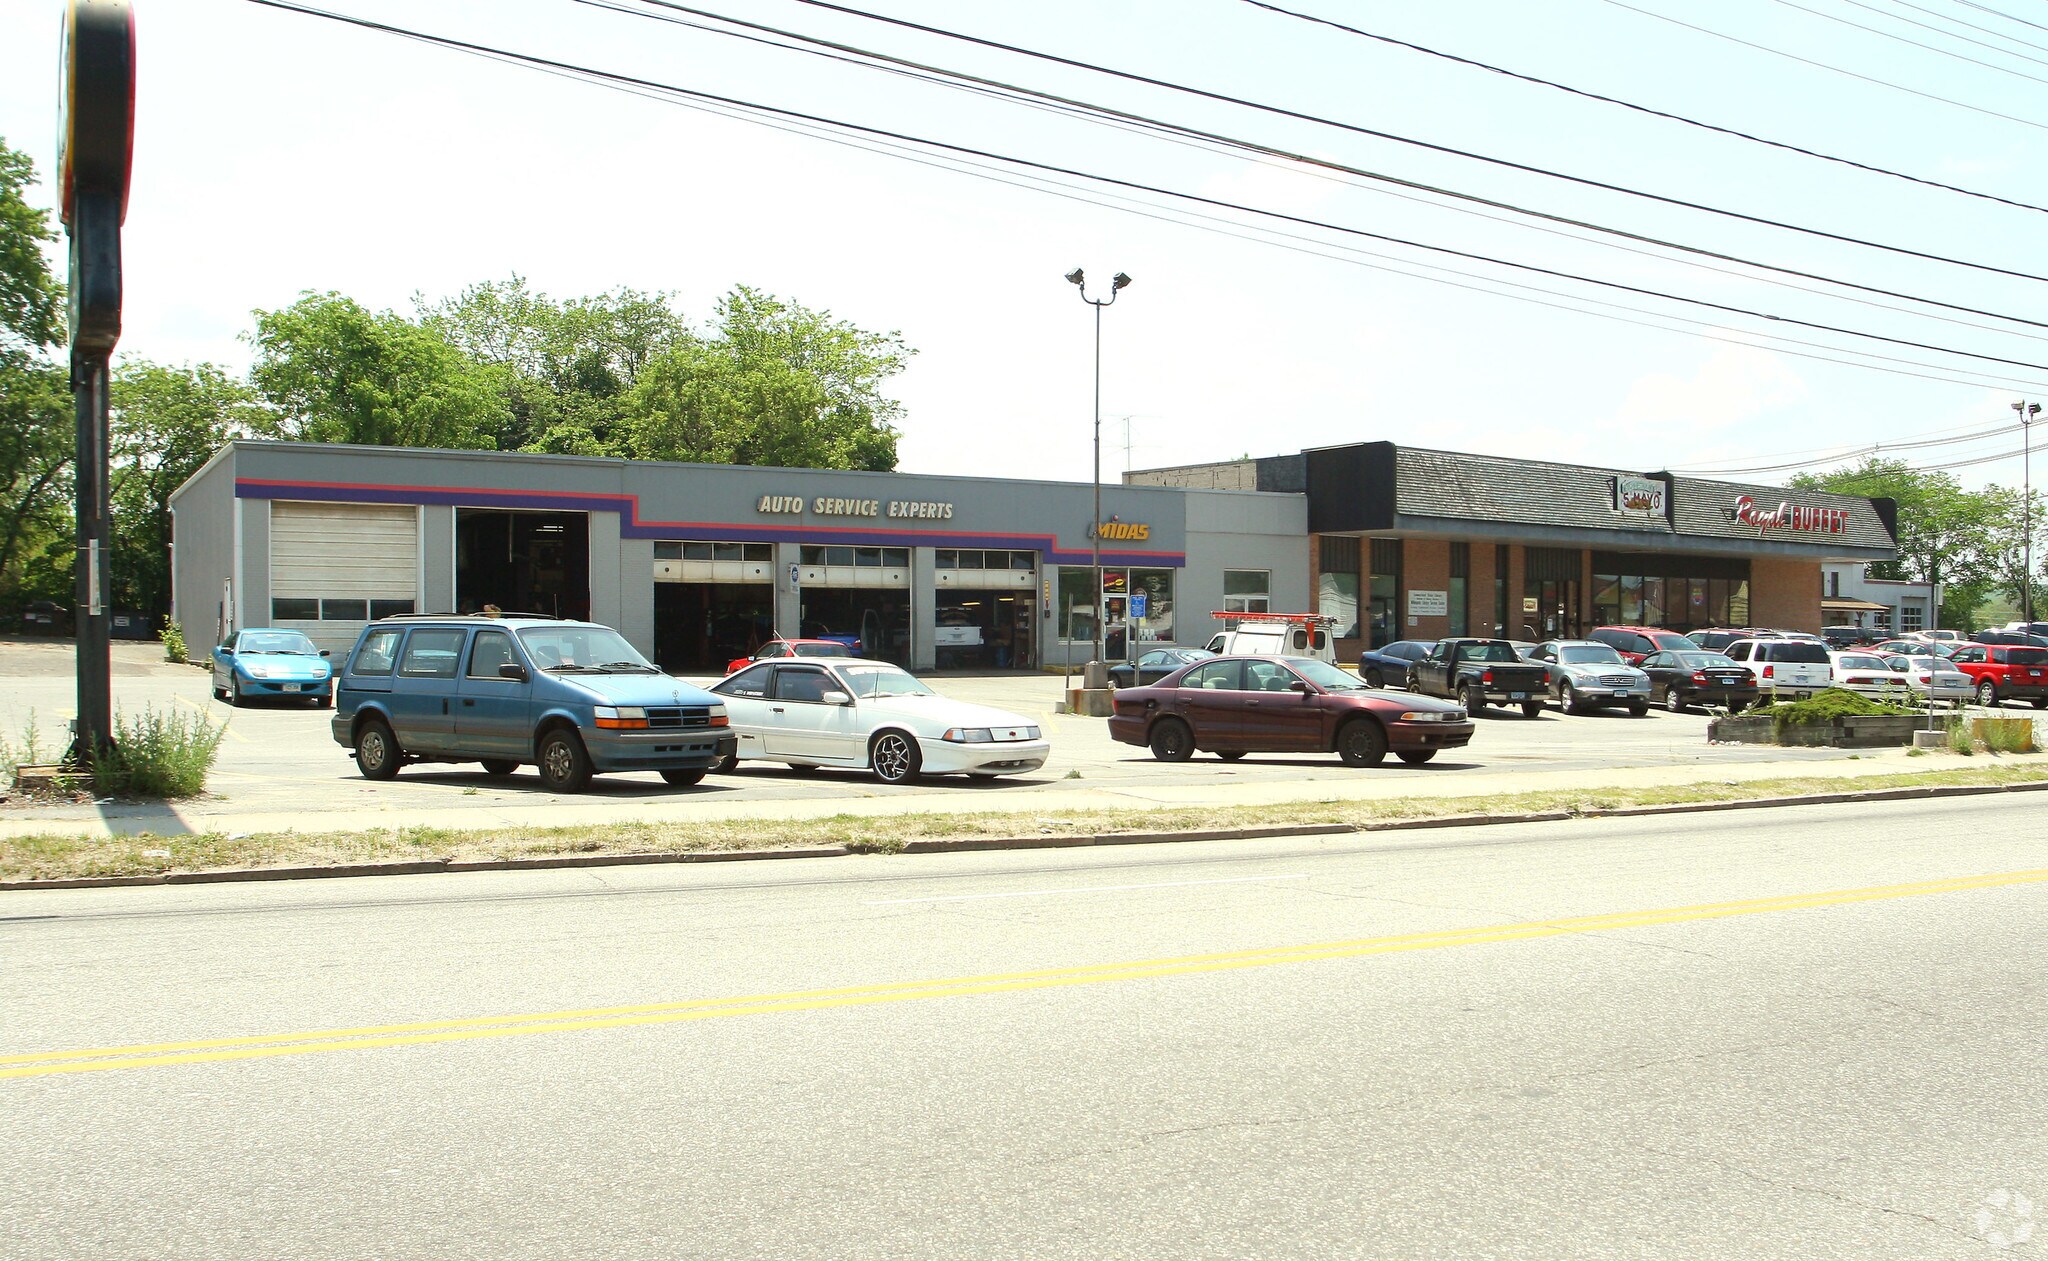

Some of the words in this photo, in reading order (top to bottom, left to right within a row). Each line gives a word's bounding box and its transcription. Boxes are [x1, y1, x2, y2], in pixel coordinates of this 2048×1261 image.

[758, 495, 804, 514] AUTO
[812, 497, 879, 517] SERVICE
[887, 501, 953, 519] EXPERTS
[1734, 495, 1788, 537] Royal
[1791, 505, 1850, 534] BUFFET
[1095, 522, 1150, 540] MIDAS
